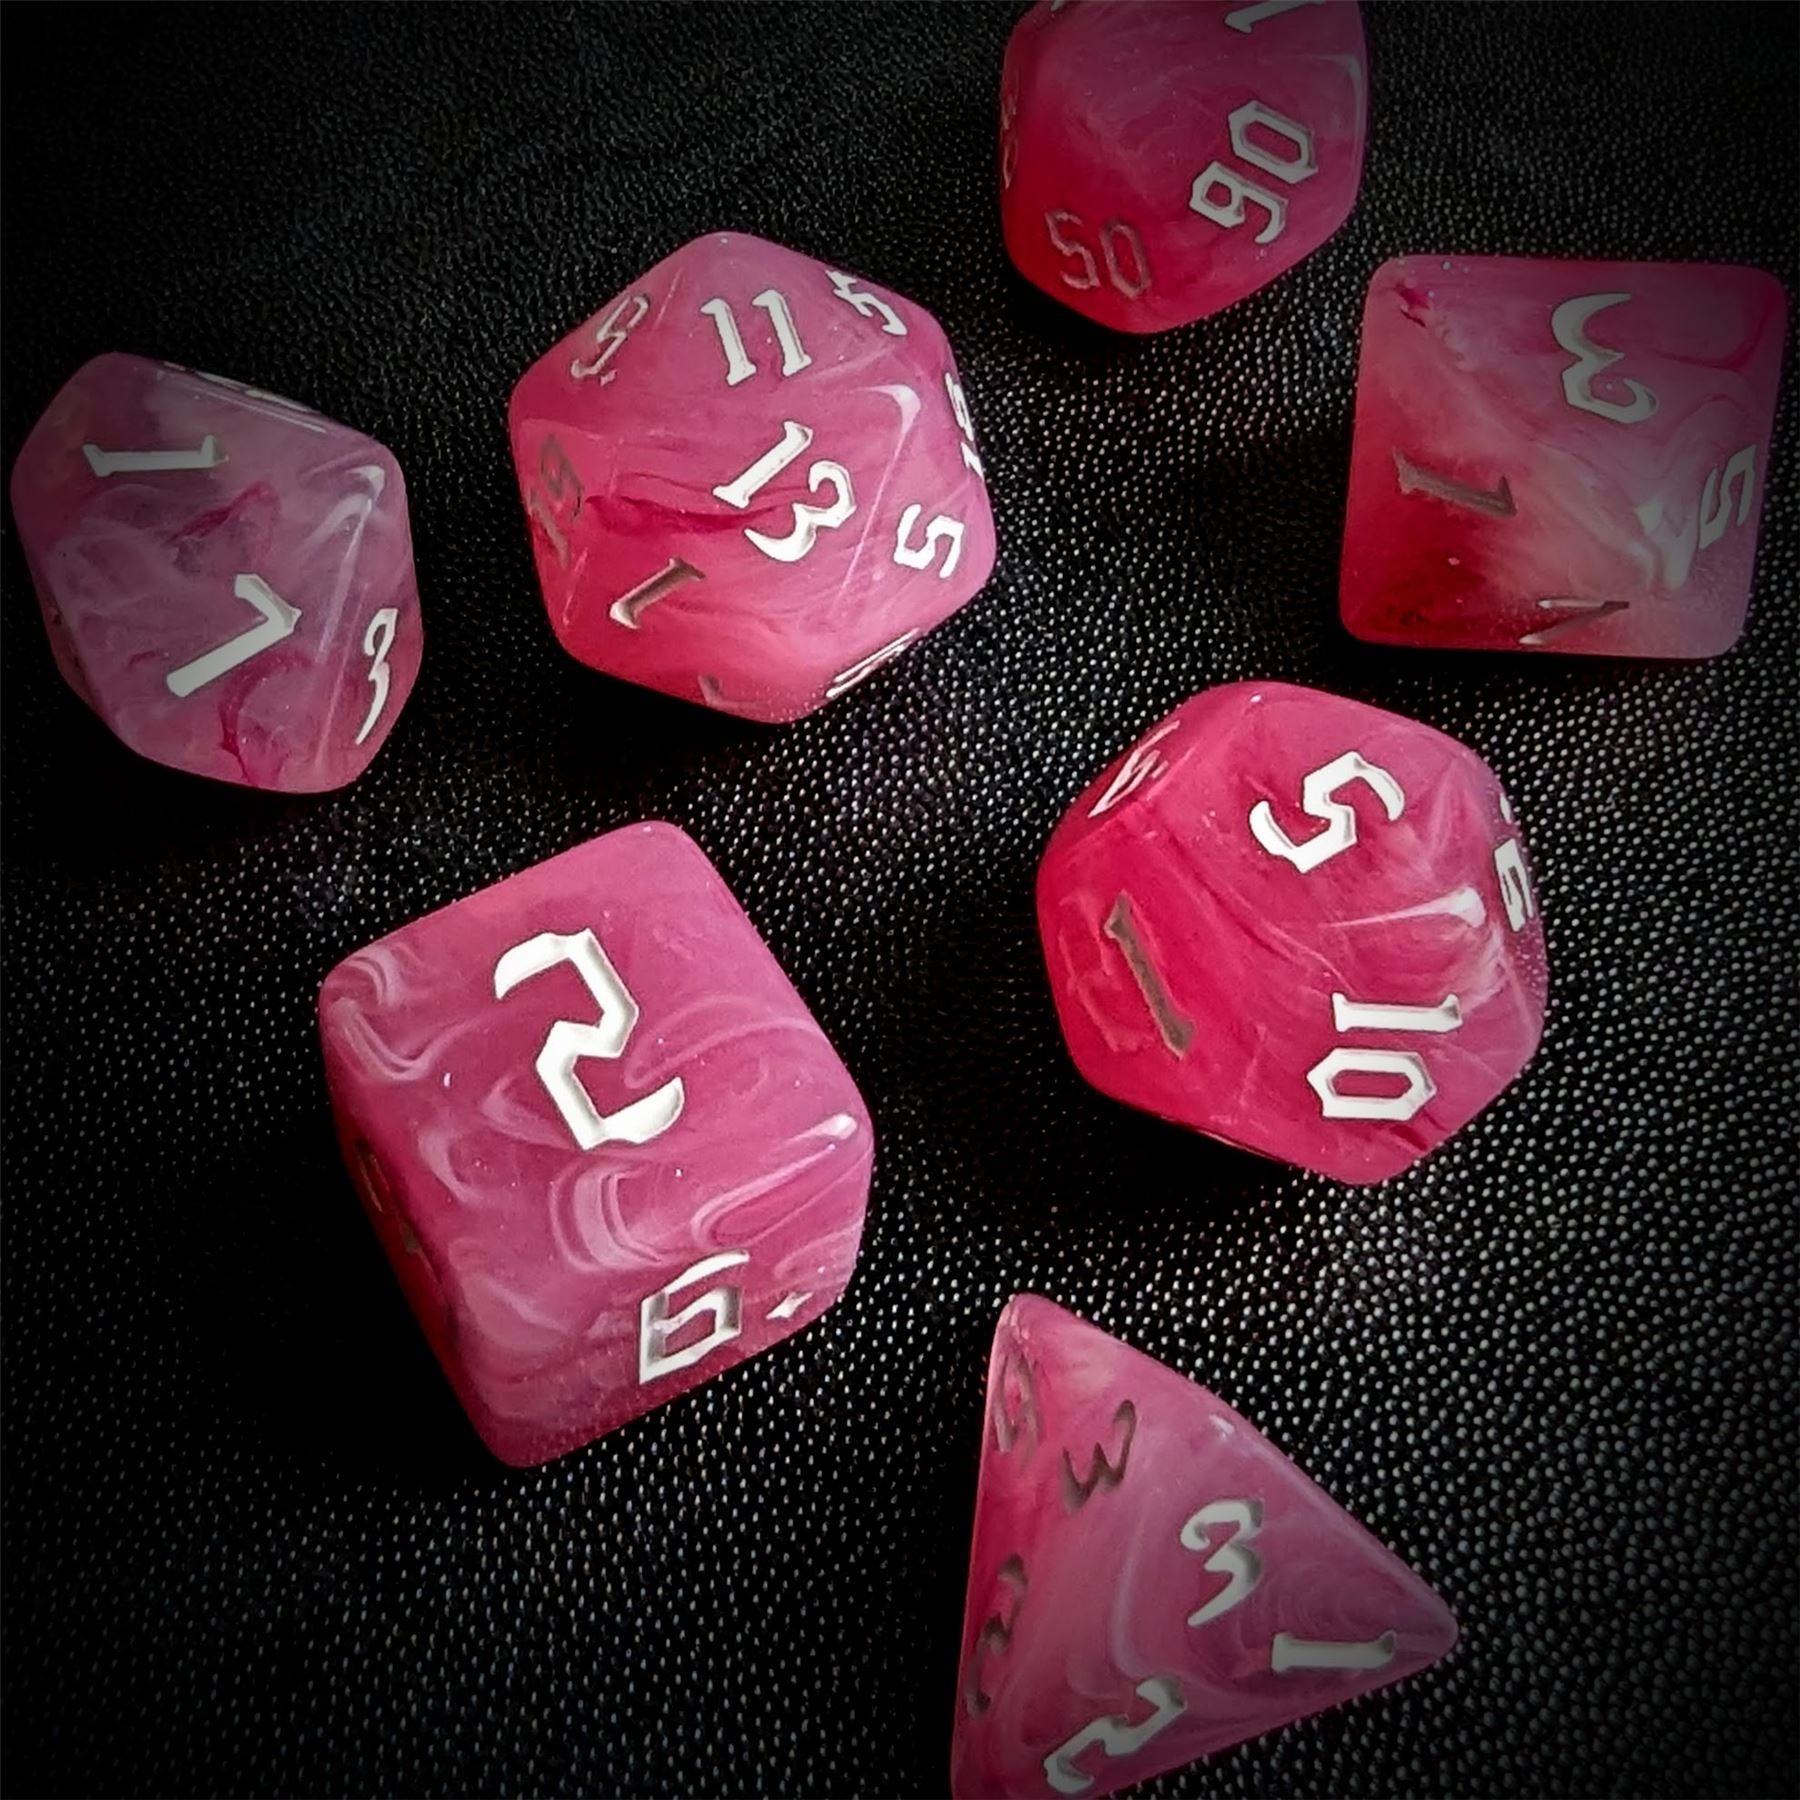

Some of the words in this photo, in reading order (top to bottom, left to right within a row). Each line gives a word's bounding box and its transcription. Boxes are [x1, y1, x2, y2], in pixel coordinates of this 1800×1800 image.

[1189, 100, 1319, 245] 90
[1045, 208, 1151, 300] 50
[701, 288, 812, 387] 11
[1551, 292, 1659, 424] 3
[83, 434, 221, 478] 1
[713, 420, 857, 563] 13
[1392, 446, 1517, 519] 1
[1699, 443, 1757, 551] 5
[608, 556, 706, 631] 1
[893, 503, 965, 580] 5
[167, 573, 303, 698] 7
[356, 608, 399, 746] 3
[1248, 750, 1406, 873] 5
[493, 927, 687, 1151] 2
[1306, 991, 1464, 1122] 10
[1180, 1496, 1265, 1628] 3
[1271, 1630, 1398, 1674] 1
[1043, 1676, 1189, 1796] 2
